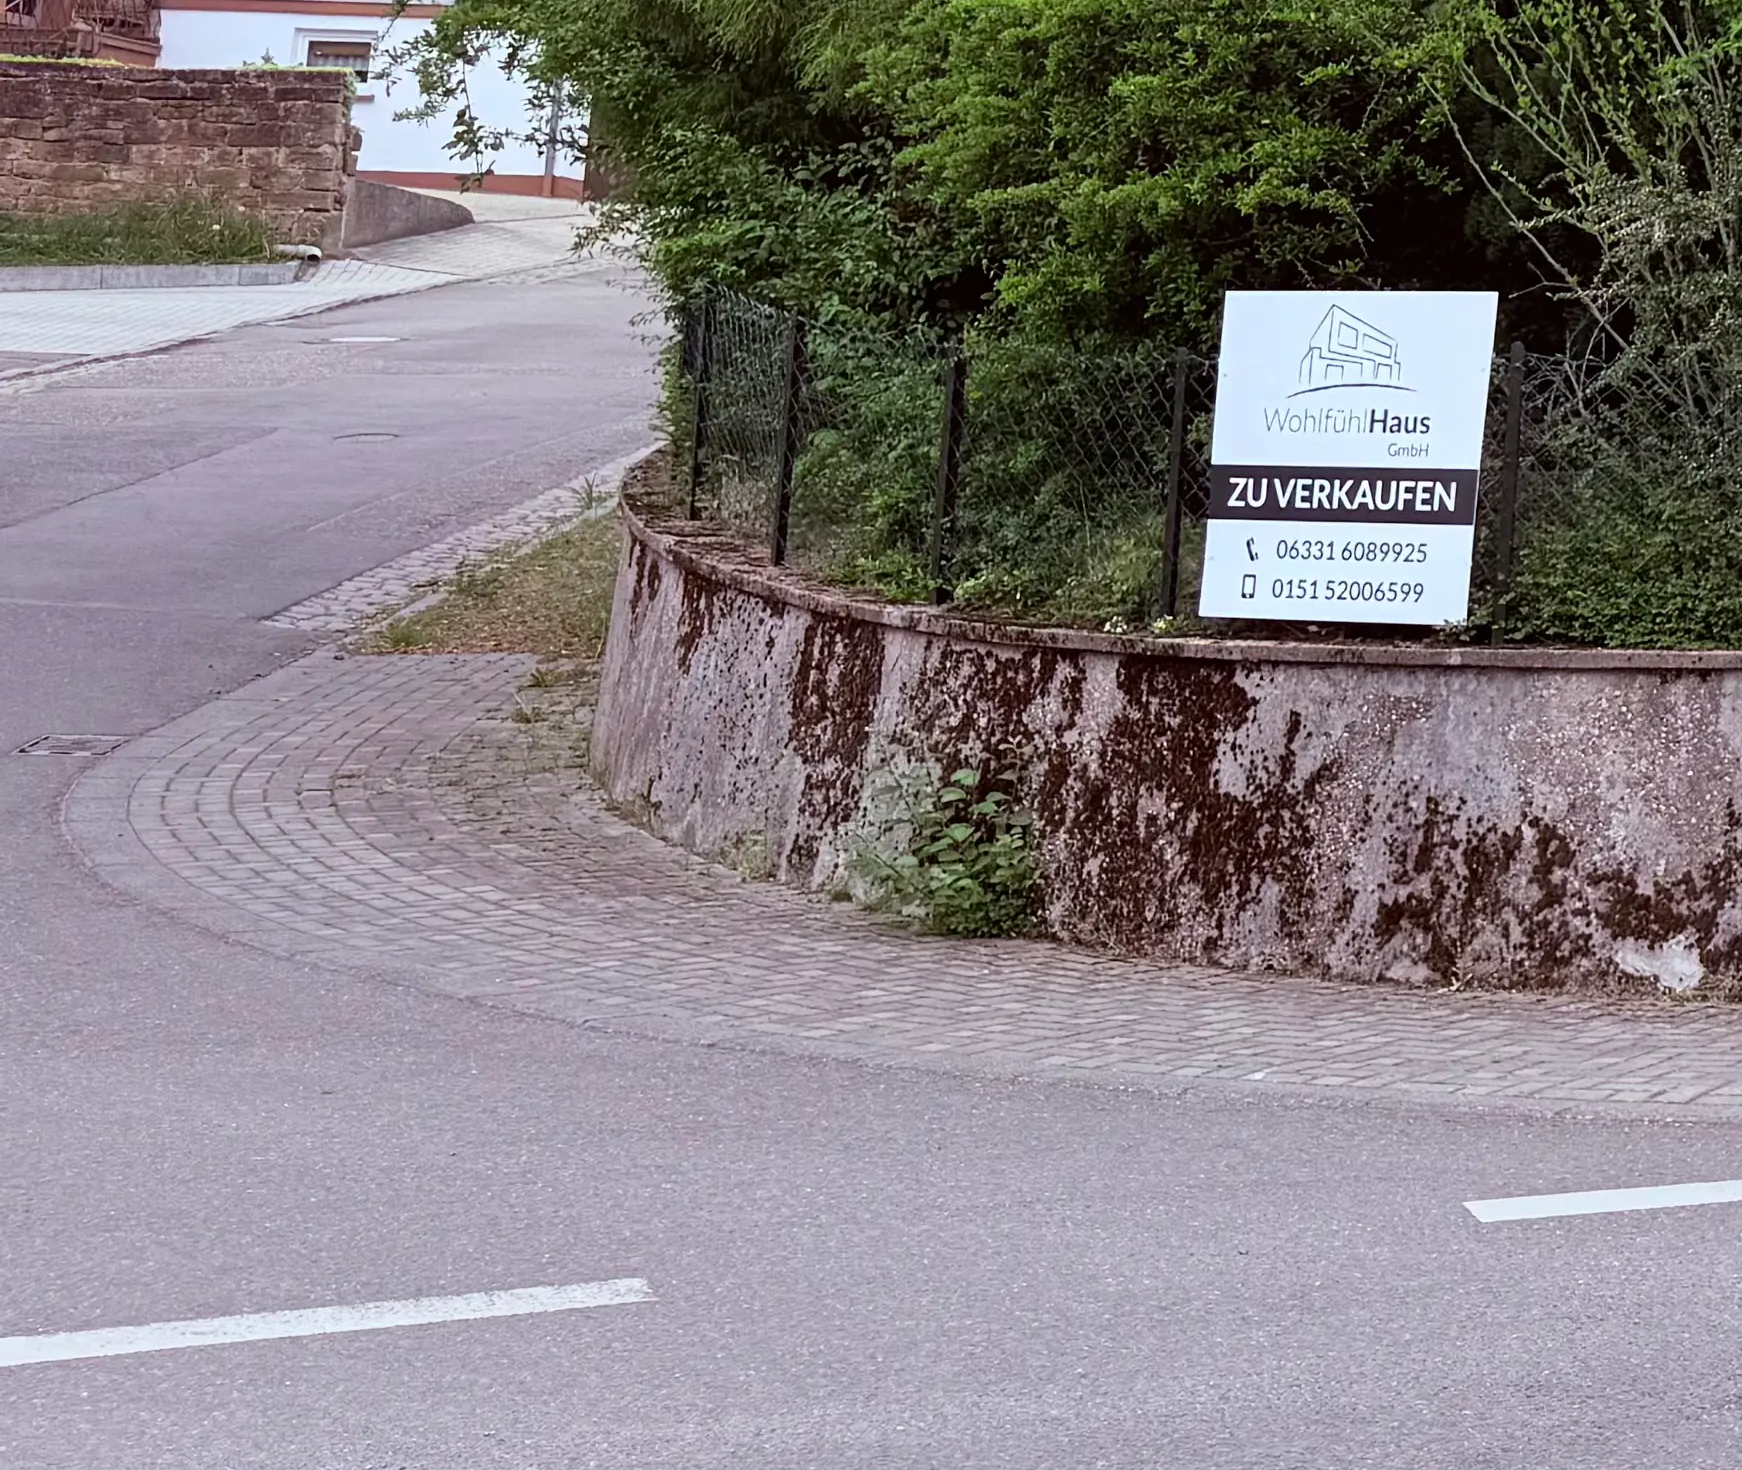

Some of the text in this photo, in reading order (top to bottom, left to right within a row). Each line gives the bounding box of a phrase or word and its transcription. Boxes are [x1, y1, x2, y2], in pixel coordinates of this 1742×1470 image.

[1264, 406, 1431, 434] WohlfühlHaus
[1387, 443, 1429, 458] GmbH
[1227, 477, 1457, 512] ZU VERKAUFEN
[1276, 539, 1428, 563] 06331 6089925
[1272, 578, 1424, 603] 0151 52006599
